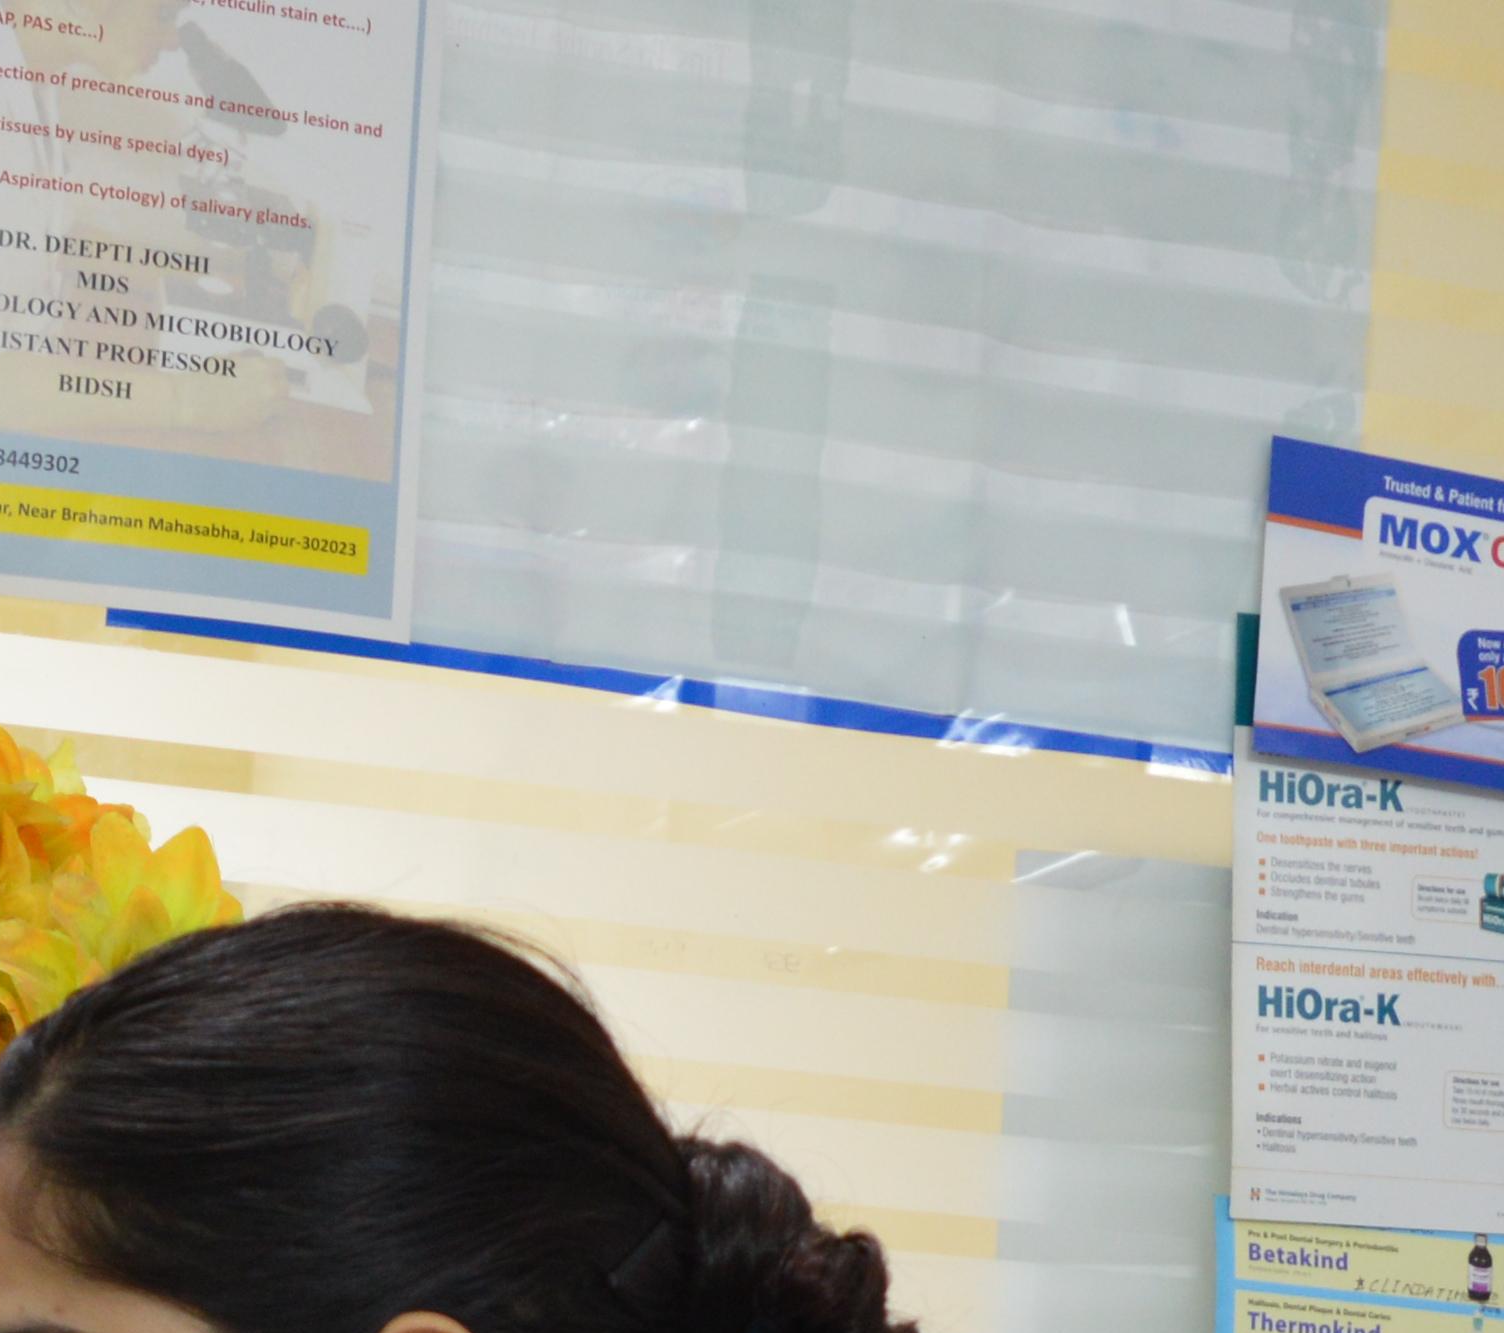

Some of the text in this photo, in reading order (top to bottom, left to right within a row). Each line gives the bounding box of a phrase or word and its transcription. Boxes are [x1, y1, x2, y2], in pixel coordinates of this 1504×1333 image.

[23, 14, 53, 32] PAS
[280, 5, 319, 23] stain
[50, 72, 69, 87] of
[71, 78, 180, 104] precancerous
[184, 91, 215, 110] and
[219, 97, 299, 123] cancerous
[303, 110, 350, 132] lesion
[354, 121, 384, 139] and
[55, 123, 75, 143] by
[79, 130, 122, 150] using
[127, 136, 182, 157] special
[186, 144, 230, 167] dyes)
[89, 182, 165, 209] Cytology)
[170, 193, 187, 209] of
[191, 196, 252, 223] salivary
[256, 207, 313, 230] glands.
[45, 235, 134, 264] DEEPTI
[139, 247, 210, 275] JOSHI
[76, 270, 130, 295] MDS
[86, 305, 137, 328] AND
[144, 312, 340, 358] MICROBIOLOGY
[95, 342, 238, 378] PROFESSOR
[58, 373, 132, 400] BIDSH
[1383, 475, 1431, 499] Trusted
[1434, 487, 1444, 502] &
[1448, 489, 1494, 511] Patient
[17, 502, 57, 521] Near
[61, 506, 144, 530] Brahaman
[148, 516, 245, 543] Mahasabha,
[248, 529, 358, 558] Jaipur-302023
[1477, 637, 1501, 649] Now
[1478, 652, 1500, 665] only
[1257, 769, 1404, 813] HiOra-K
[1256, 831, 1277, 843] One
[1281, 833, 1333, 848] toothpaste
[1336, 838, 1357, 850] with
[1360, 839, 1387, 852] three
[1389, 842, 1437, 858] important
[1328, 861, 1341, 873] the
[1325, 890, 1338, 901] the
[1256, 909, 1298, 921] Indication
[1256, 956, 1467, 988] Reach interdental areas effectively
[1257, 984, 1401, 1027] HiOra-K
[1256, 1024, 1268, 1033] For
[1336, 1029, 1351, 1040] and
[1346, 1059, 1362, 1069] and
[1256, 1112, 1302, 1125] Indications
[1247, 1242, 1349, 1271] Betakind
